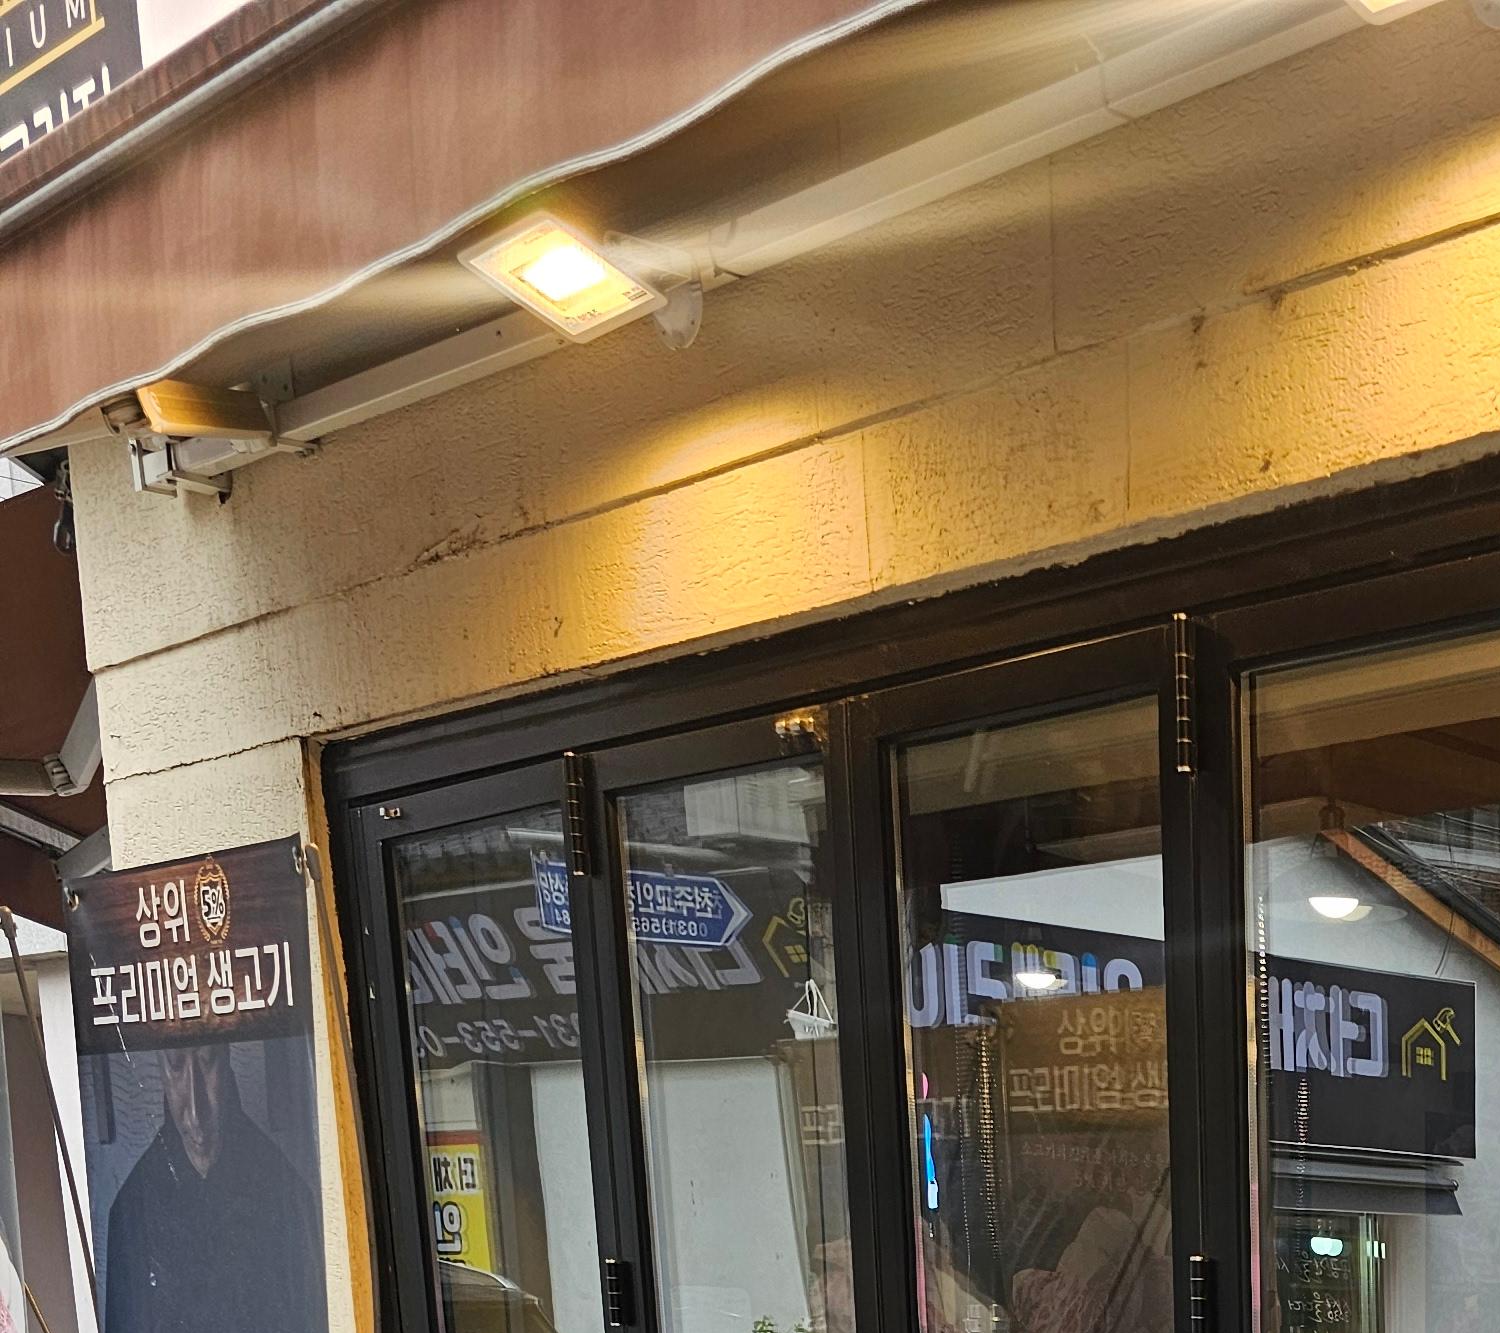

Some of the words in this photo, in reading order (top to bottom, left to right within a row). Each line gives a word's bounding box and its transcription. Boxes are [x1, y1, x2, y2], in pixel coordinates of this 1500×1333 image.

[136, 880, 190, 948] 상위
[91, 954, 201, 1025] 프리미엄
[207, 941, 294, 1014] 생고기
